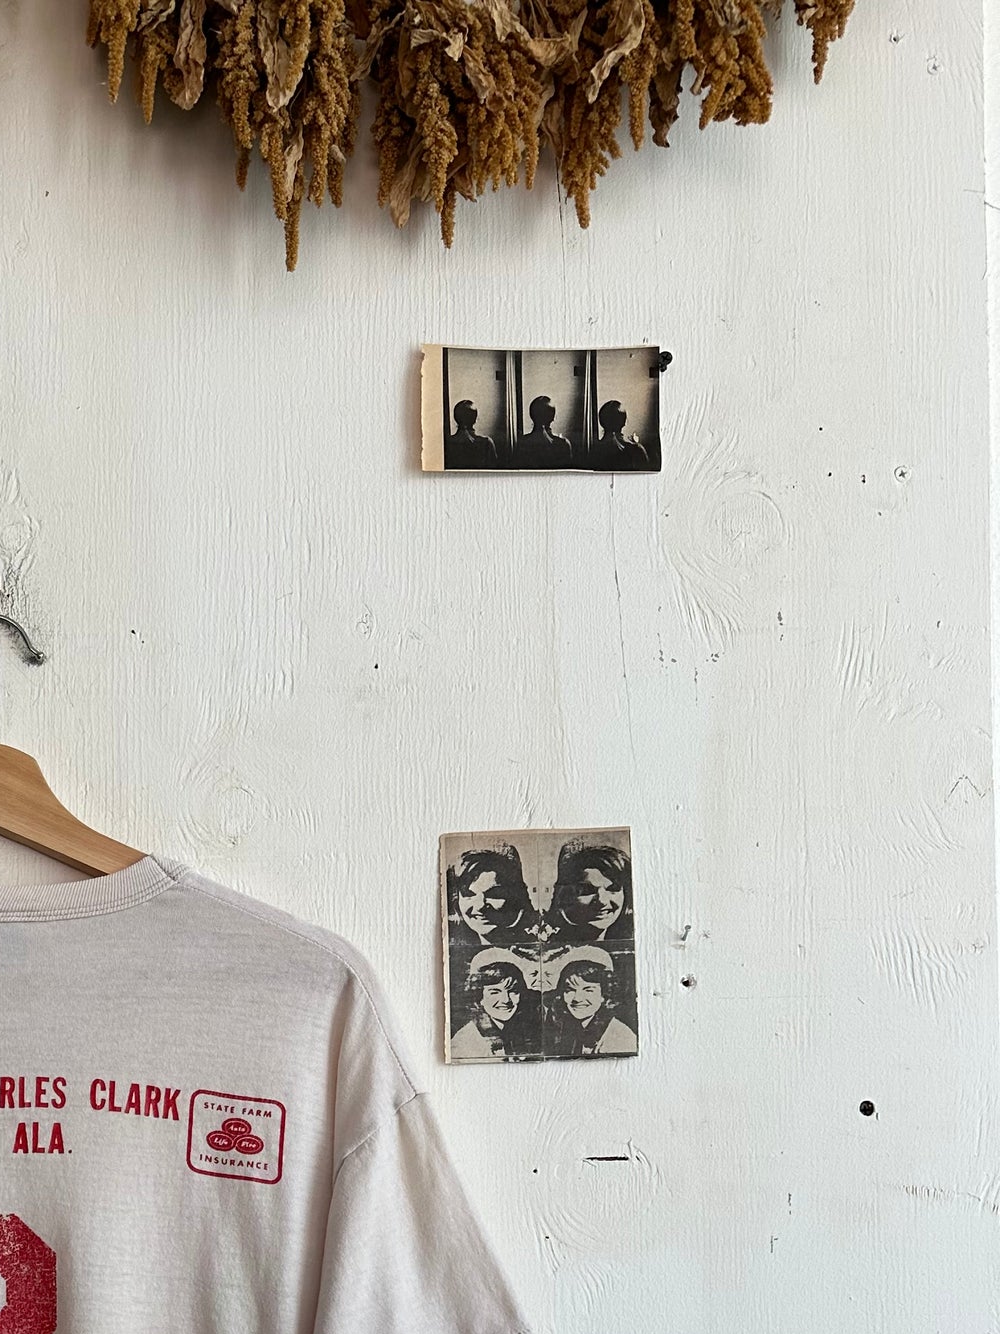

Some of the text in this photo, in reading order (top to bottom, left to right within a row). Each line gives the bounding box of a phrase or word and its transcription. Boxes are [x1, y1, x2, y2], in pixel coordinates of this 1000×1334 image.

[90, 1078, 181, 1121] CLARK
[203, 1102, 272, 1118] STATE FARM
[12, 1122, 74, 1155] ALA.
[199, 1153, 269, 1171] INSURANCE
